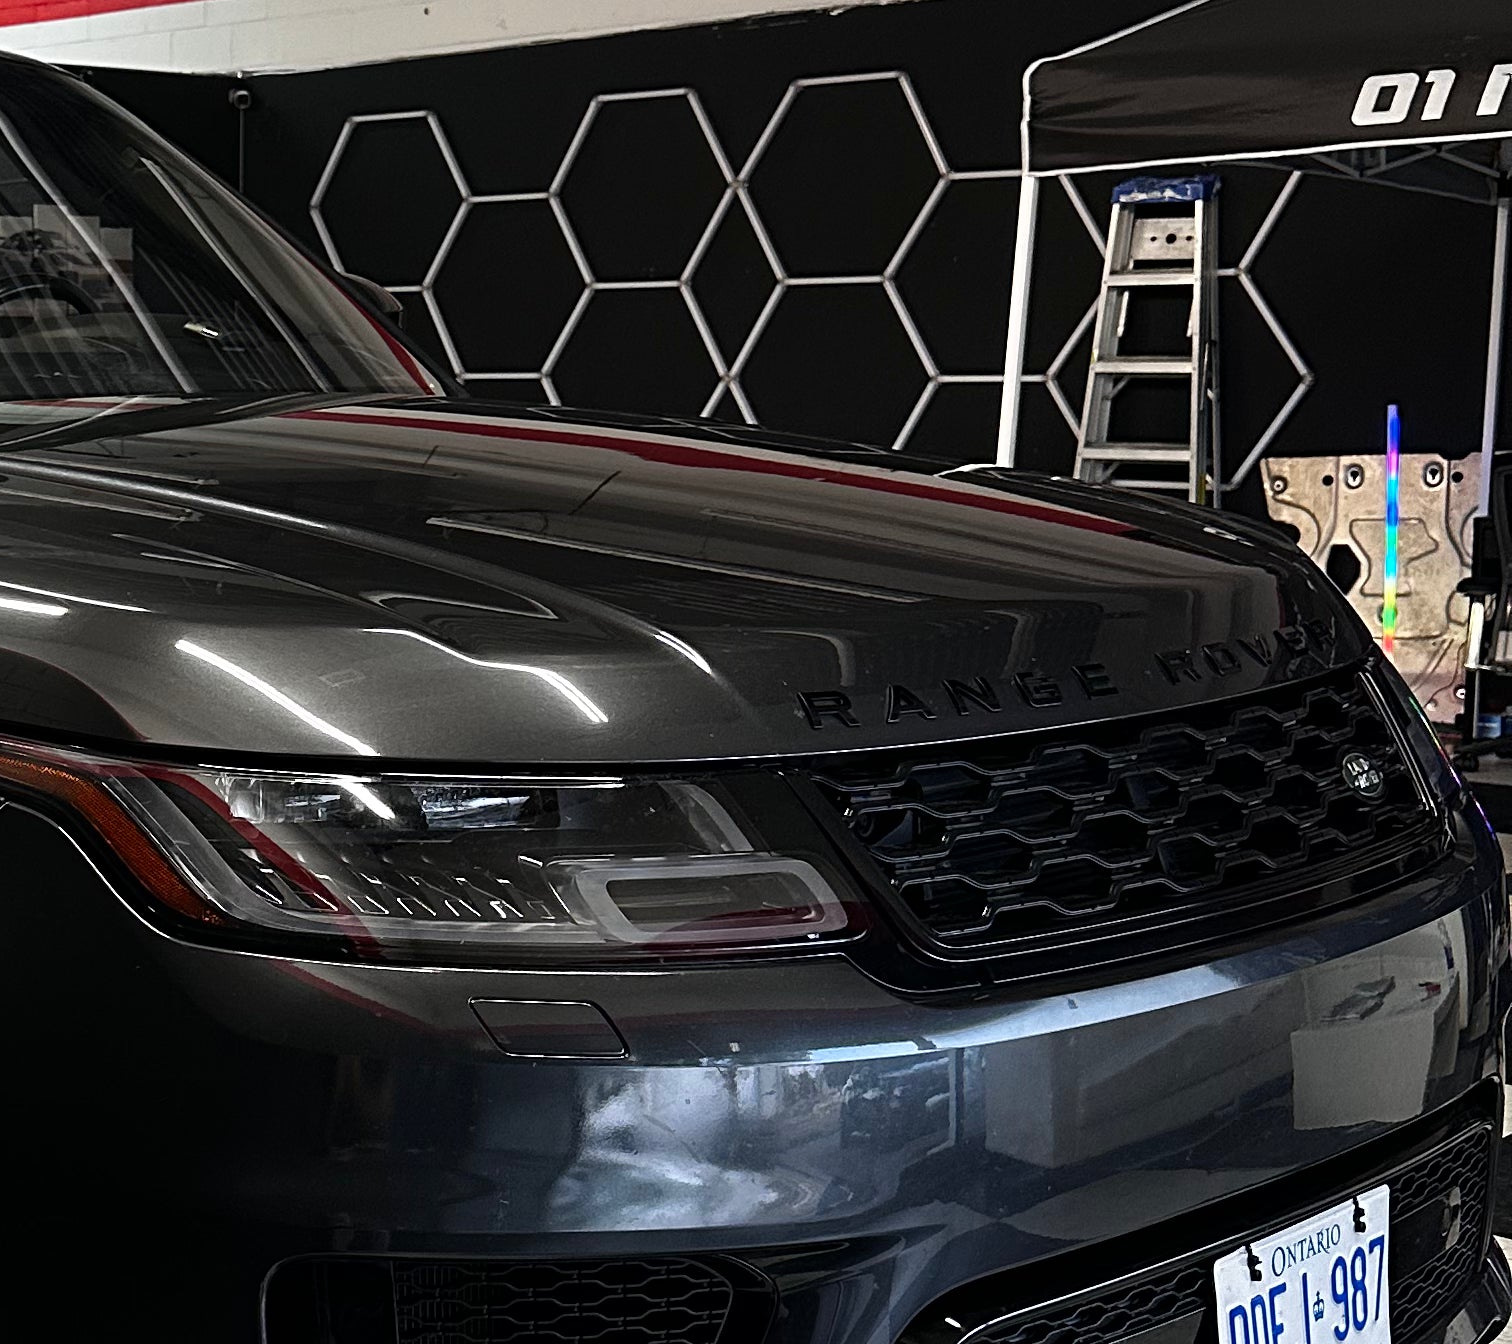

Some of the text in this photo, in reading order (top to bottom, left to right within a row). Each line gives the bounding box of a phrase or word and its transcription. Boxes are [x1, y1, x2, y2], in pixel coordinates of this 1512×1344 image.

[1350, 68, 1456, 126] 01
[797, 620, 1336, 730] RANGE ROVER
[1271, 1223, 1341, 1277] ONTARIO
[1330, 1234, 1385, 1342] 987
